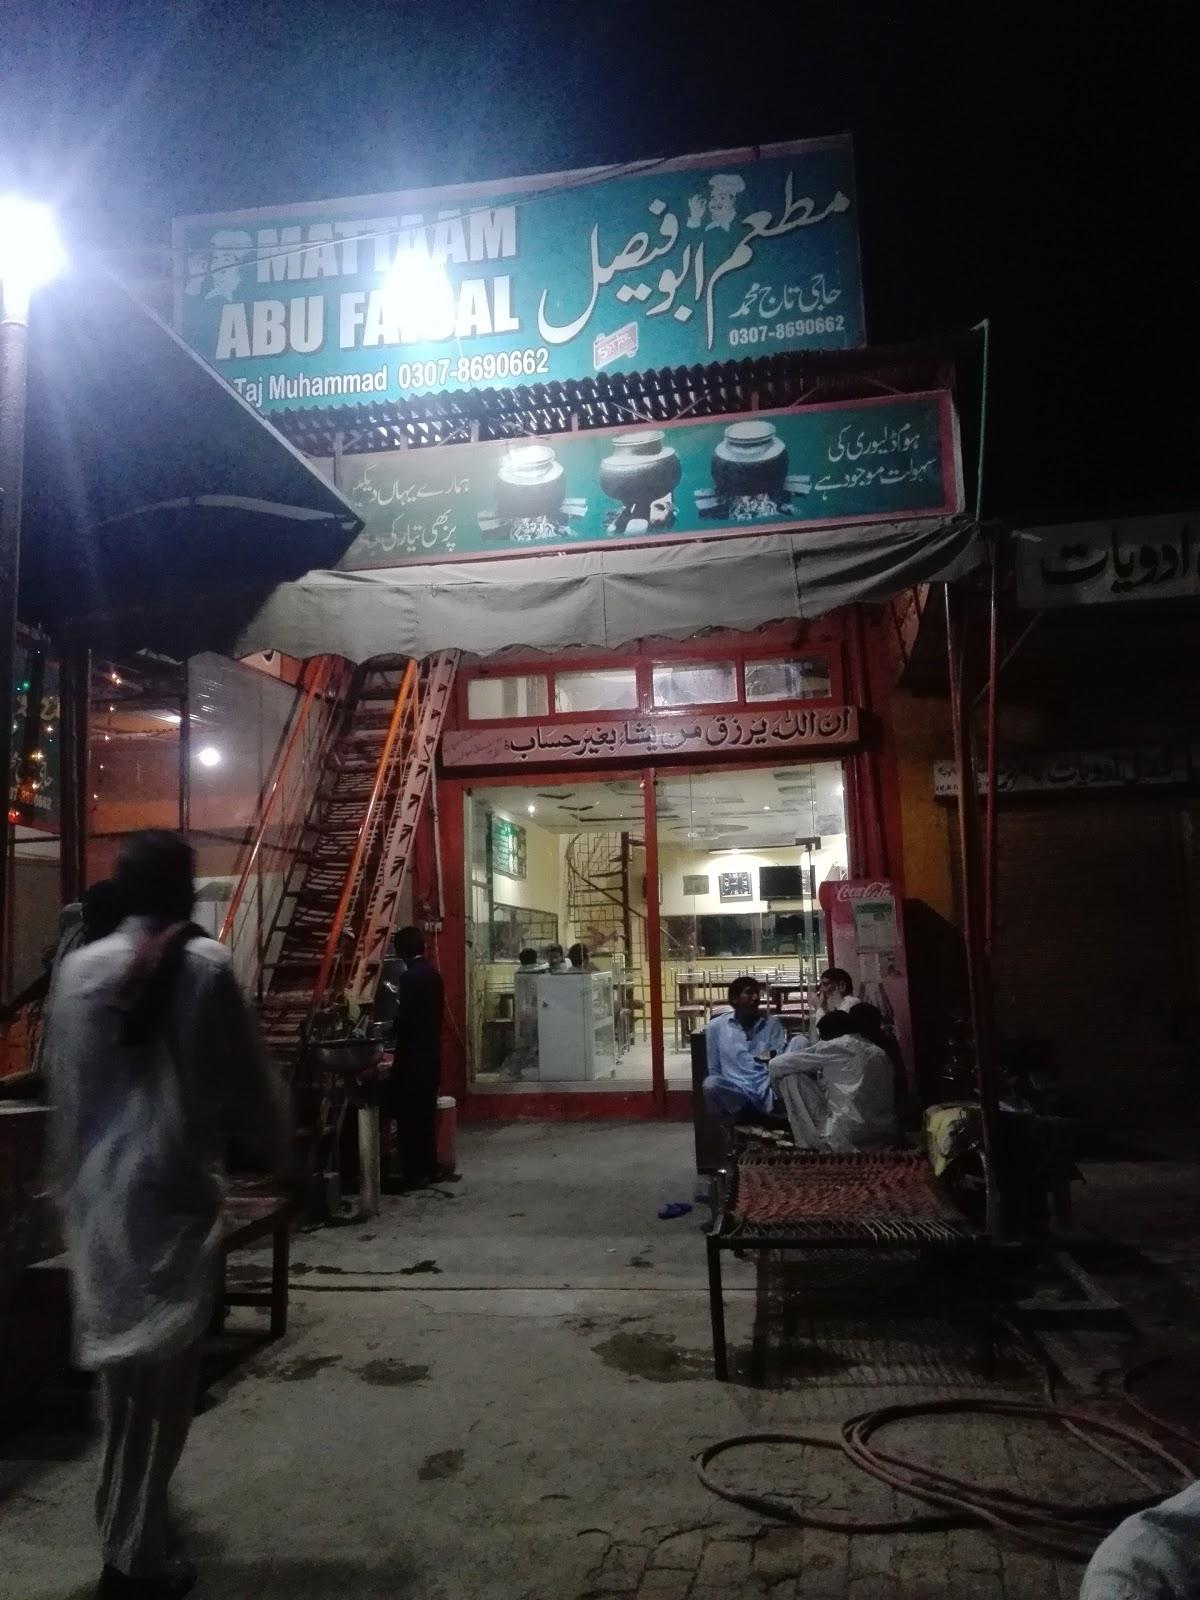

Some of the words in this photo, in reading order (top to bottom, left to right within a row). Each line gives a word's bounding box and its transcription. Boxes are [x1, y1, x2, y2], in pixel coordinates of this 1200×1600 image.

[708, 171, 849, 350] مطعم
[728, 282, 760, 318] محمد
[759, 284, 801, 318] تاج
[798, 273, 842, 312] حاجی
[215, 295, 324, 361] ABU
[729, 315, 845, 347] 0307-8690662
[233, 377, 263, 407] Taj
[269, 365, 388, 400] Muhammad
[398, 348, 549, 388] 0307-8690662
[828, 425, 853, 462] کی
[417, 475, 471, 497] ہمارے
[814, 474, 848, 500] ہے
[846, 466, 885, 488] موجود
[879, 457, 937, 485] سہولت
[377, 479, 417, 506] یہاں
[382, 513, 405, 551] کی
[397, 524, 424, 552] تیار
[421, 509, 453, 548] بھی
[511, 725, 581, 760] حساب
